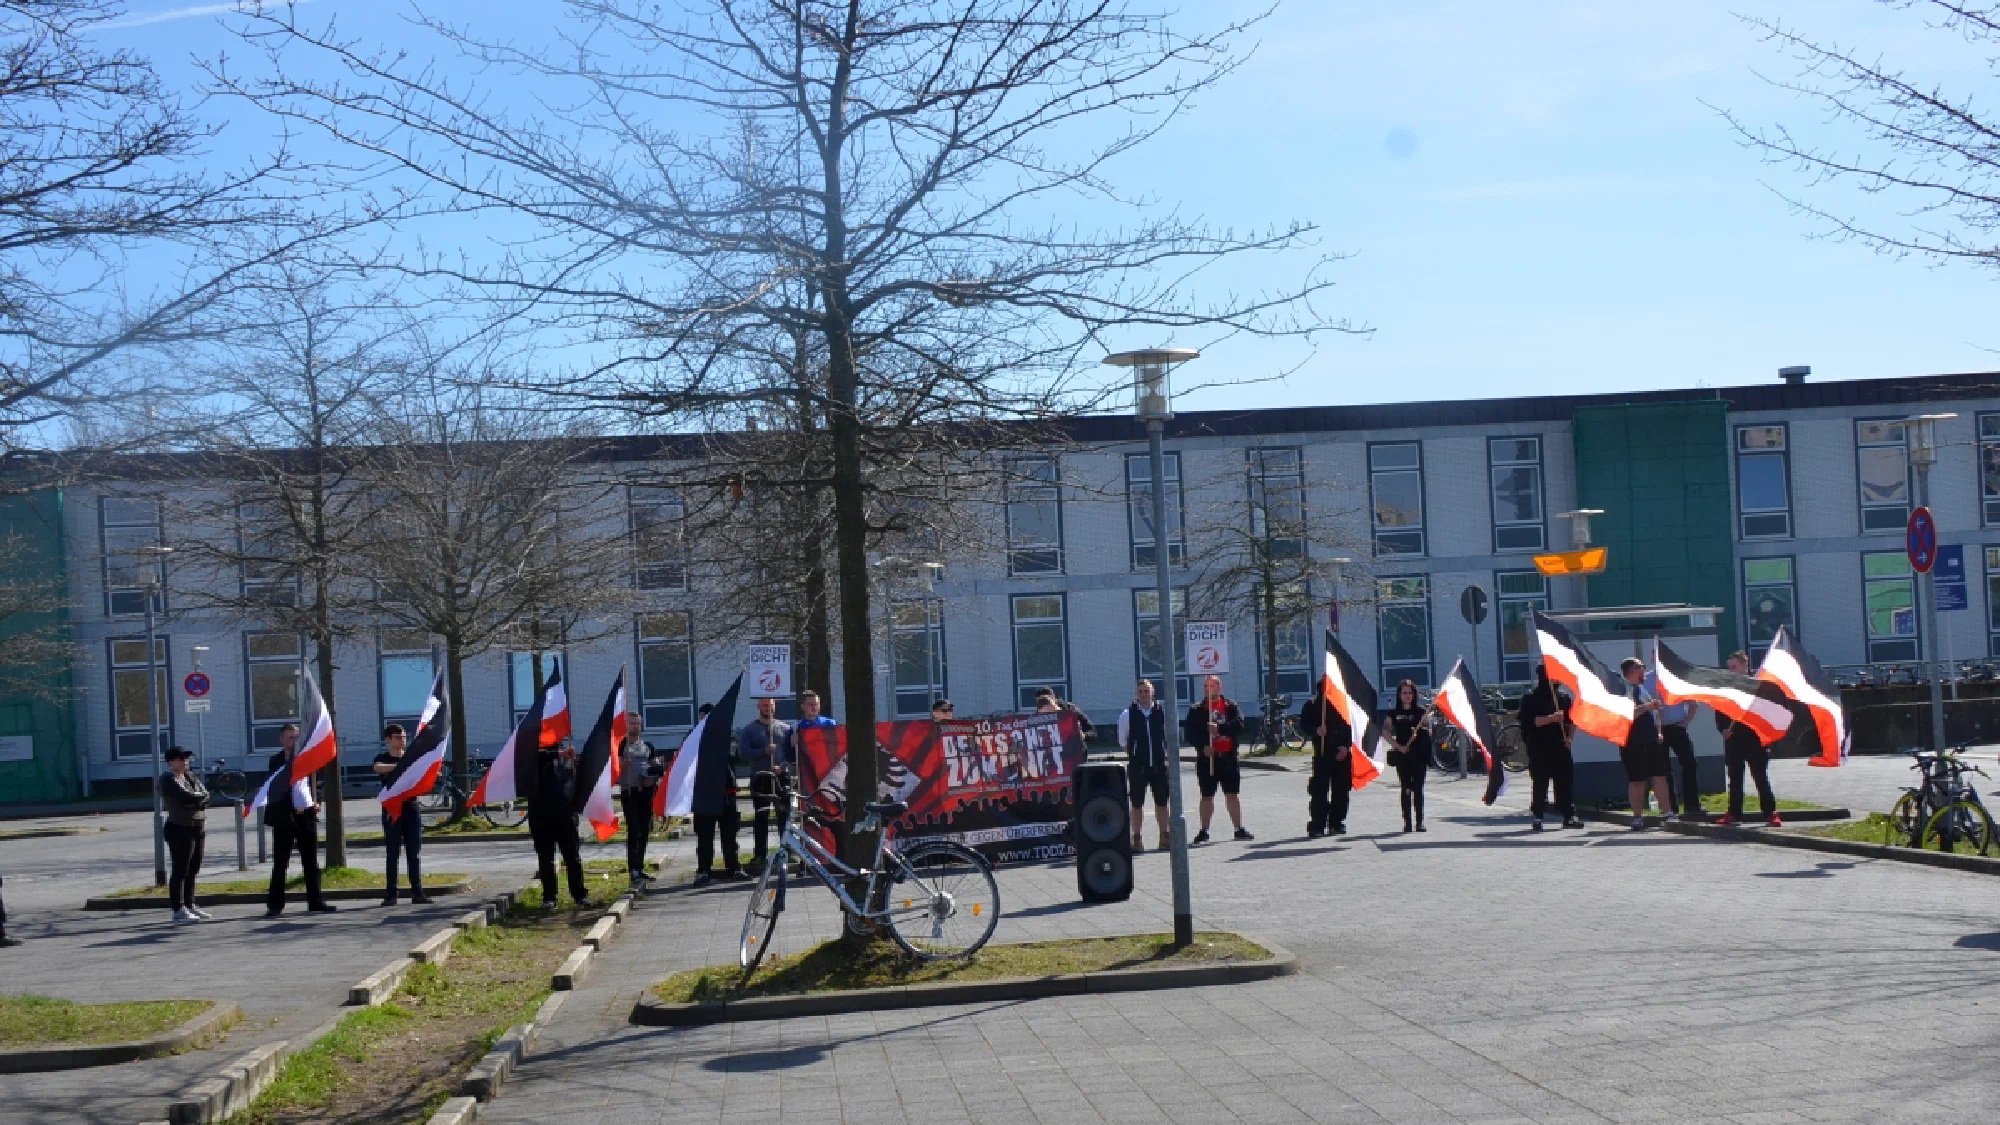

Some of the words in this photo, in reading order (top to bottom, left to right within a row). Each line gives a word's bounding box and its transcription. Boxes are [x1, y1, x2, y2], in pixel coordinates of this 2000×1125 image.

[1189, 630, 1226, 641] DICHT
[750, 653, 789, 663] DICHT
[974, 719, 994, 734] 10.
